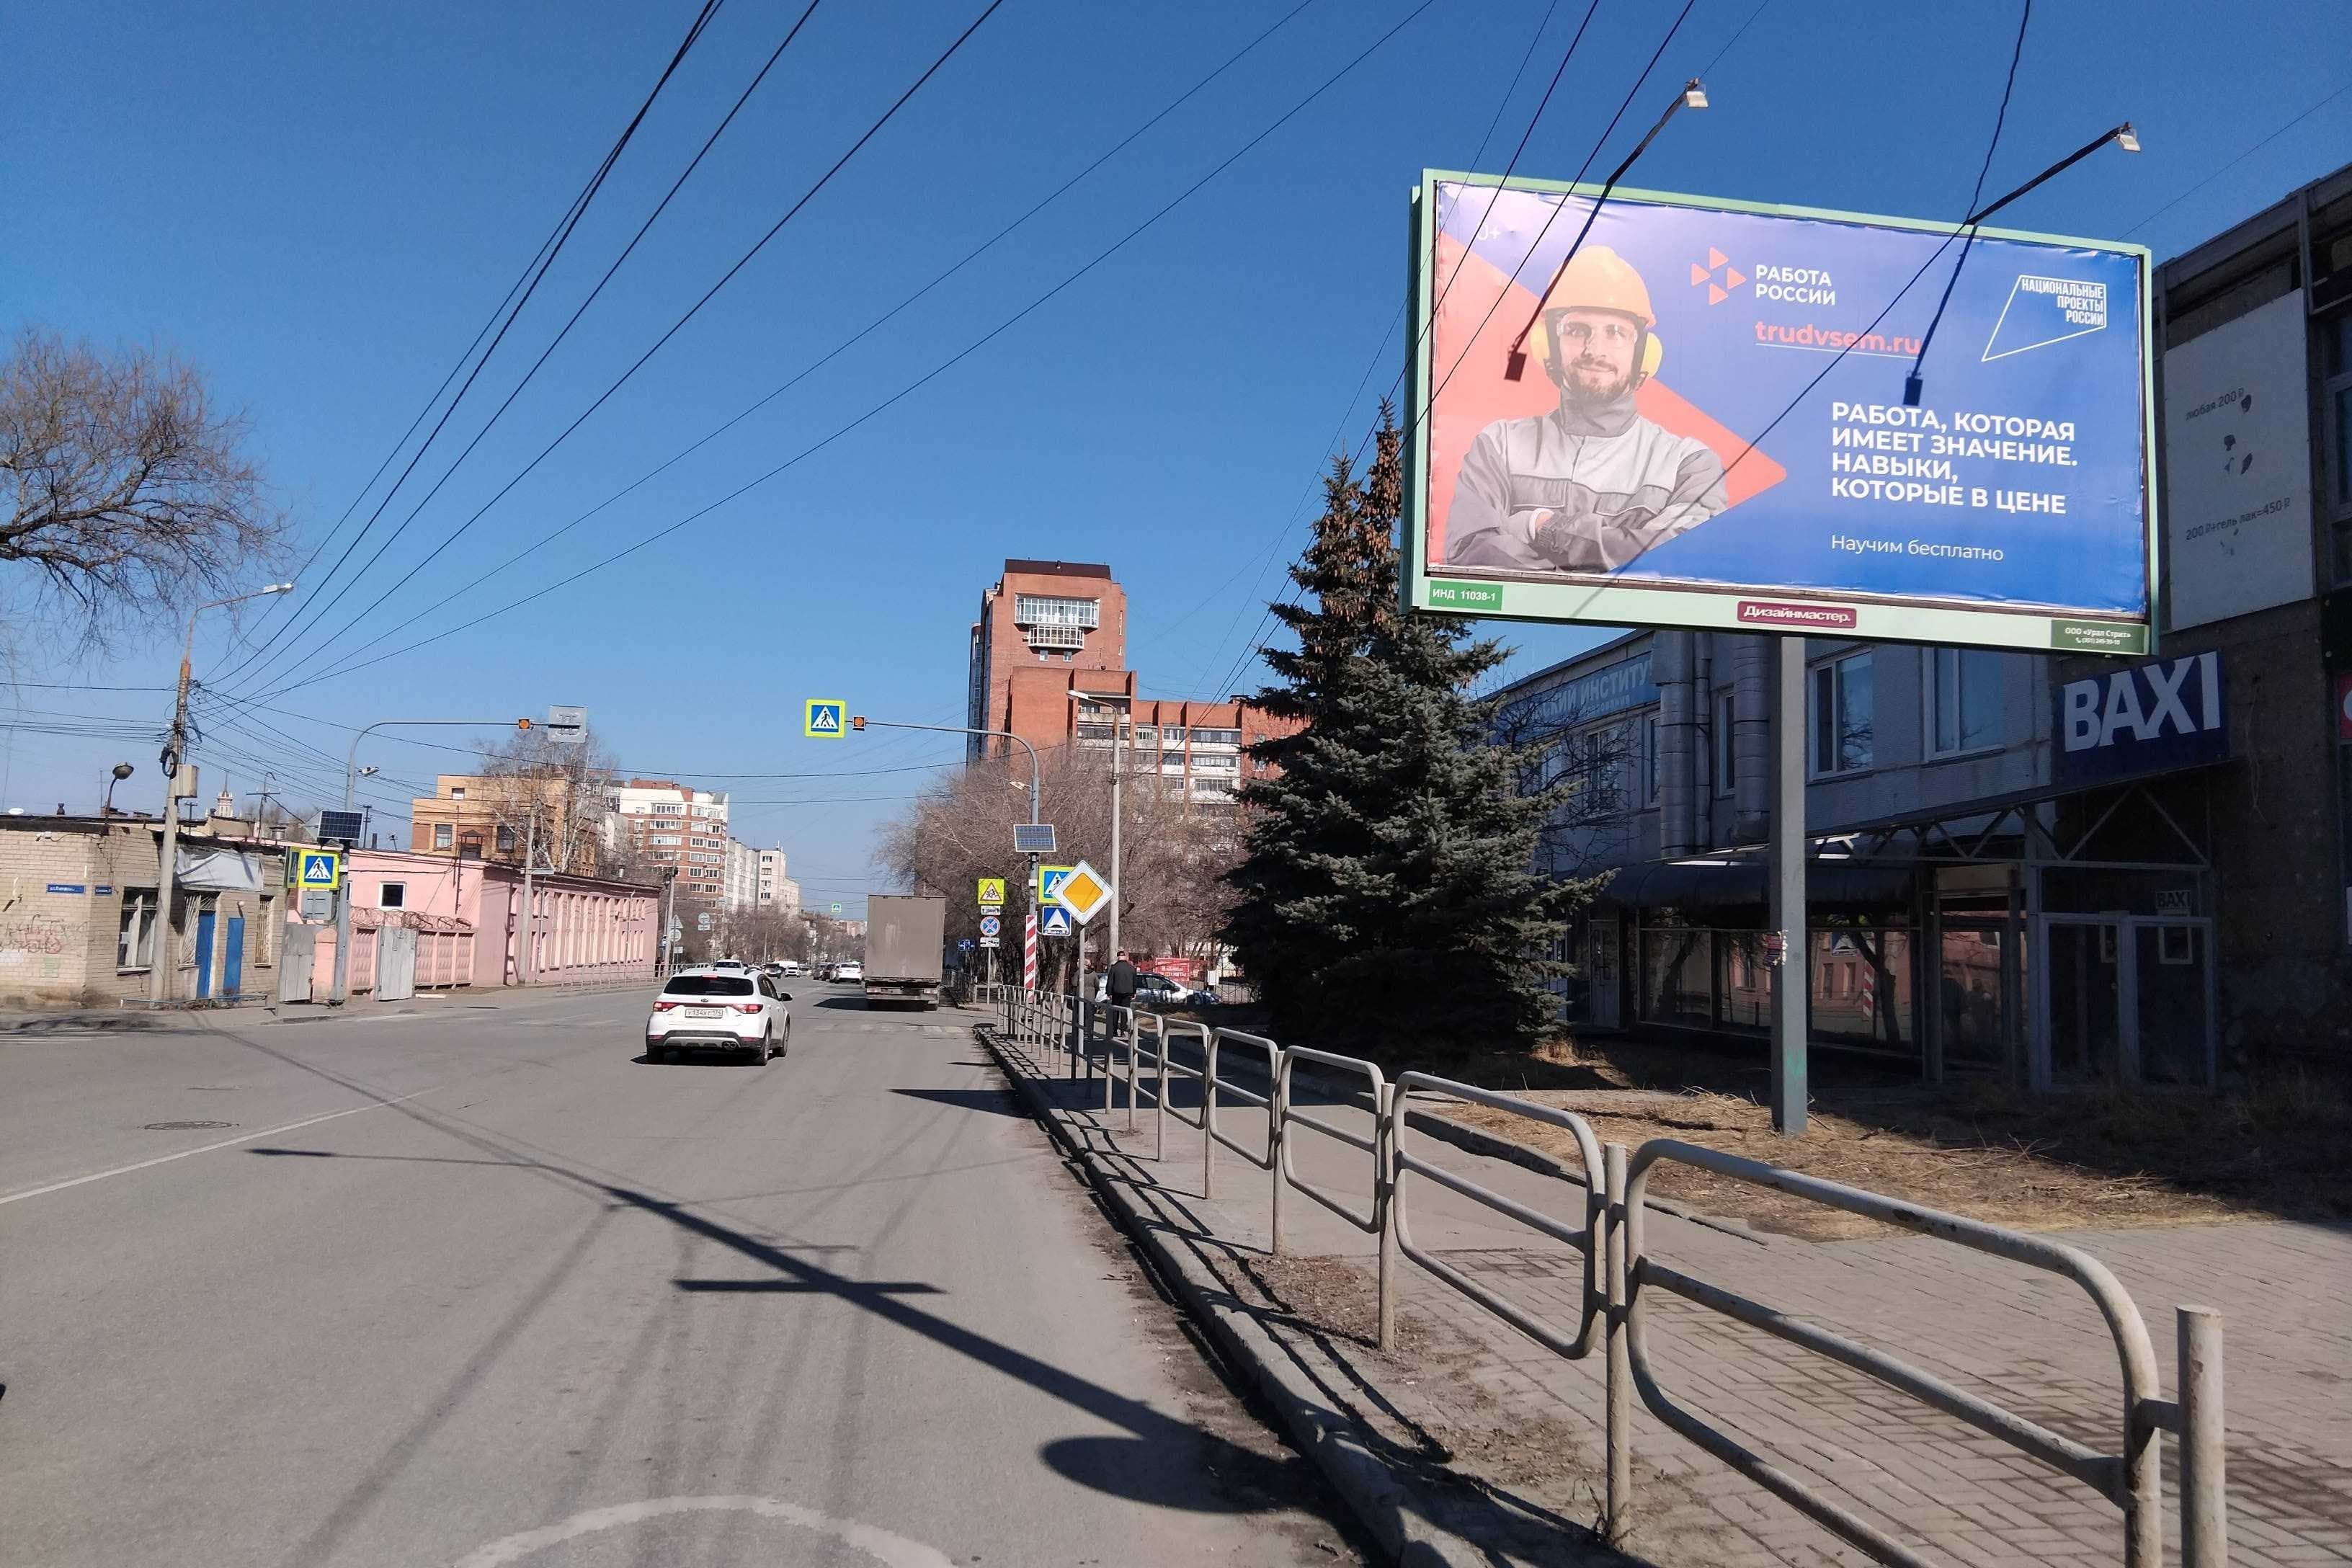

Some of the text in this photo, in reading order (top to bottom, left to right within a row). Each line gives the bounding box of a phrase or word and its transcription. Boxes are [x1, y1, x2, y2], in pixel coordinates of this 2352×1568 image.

[1756, 264, 1832, 287] РАБОТА
[1756, 284, 1835, 306] РОССИИ
[2021, 278, 2103, 299] НАЦИОНАЛЬНЫЕ
[2057, 295, 2103, 312] ПРОЕКТЫ
[2065, 310, 2103, 326] РОССИИ
[1755, 321, 1920, 355] trudvsem.ru
[1832, 401, 2075, 441] РАБОТА, КОТОРАЯ
[1832, 427, 2078, 467] ИМЕЕТ ЗНАЧЕНИЕ.
[1832, 453, 1958, 484] НАВЫКИ,
[1832, 477, 2067, 514] КОТОРЫЕ В ЦЕНЕ
[1832, 535, 2004, 561] Научим бесплатно
[1432, 588, 1496, 601] ИНД 11038-1
[2064, 651, 2220, 752] BAXI
[2157, 891, 2191, 908] BAXI
